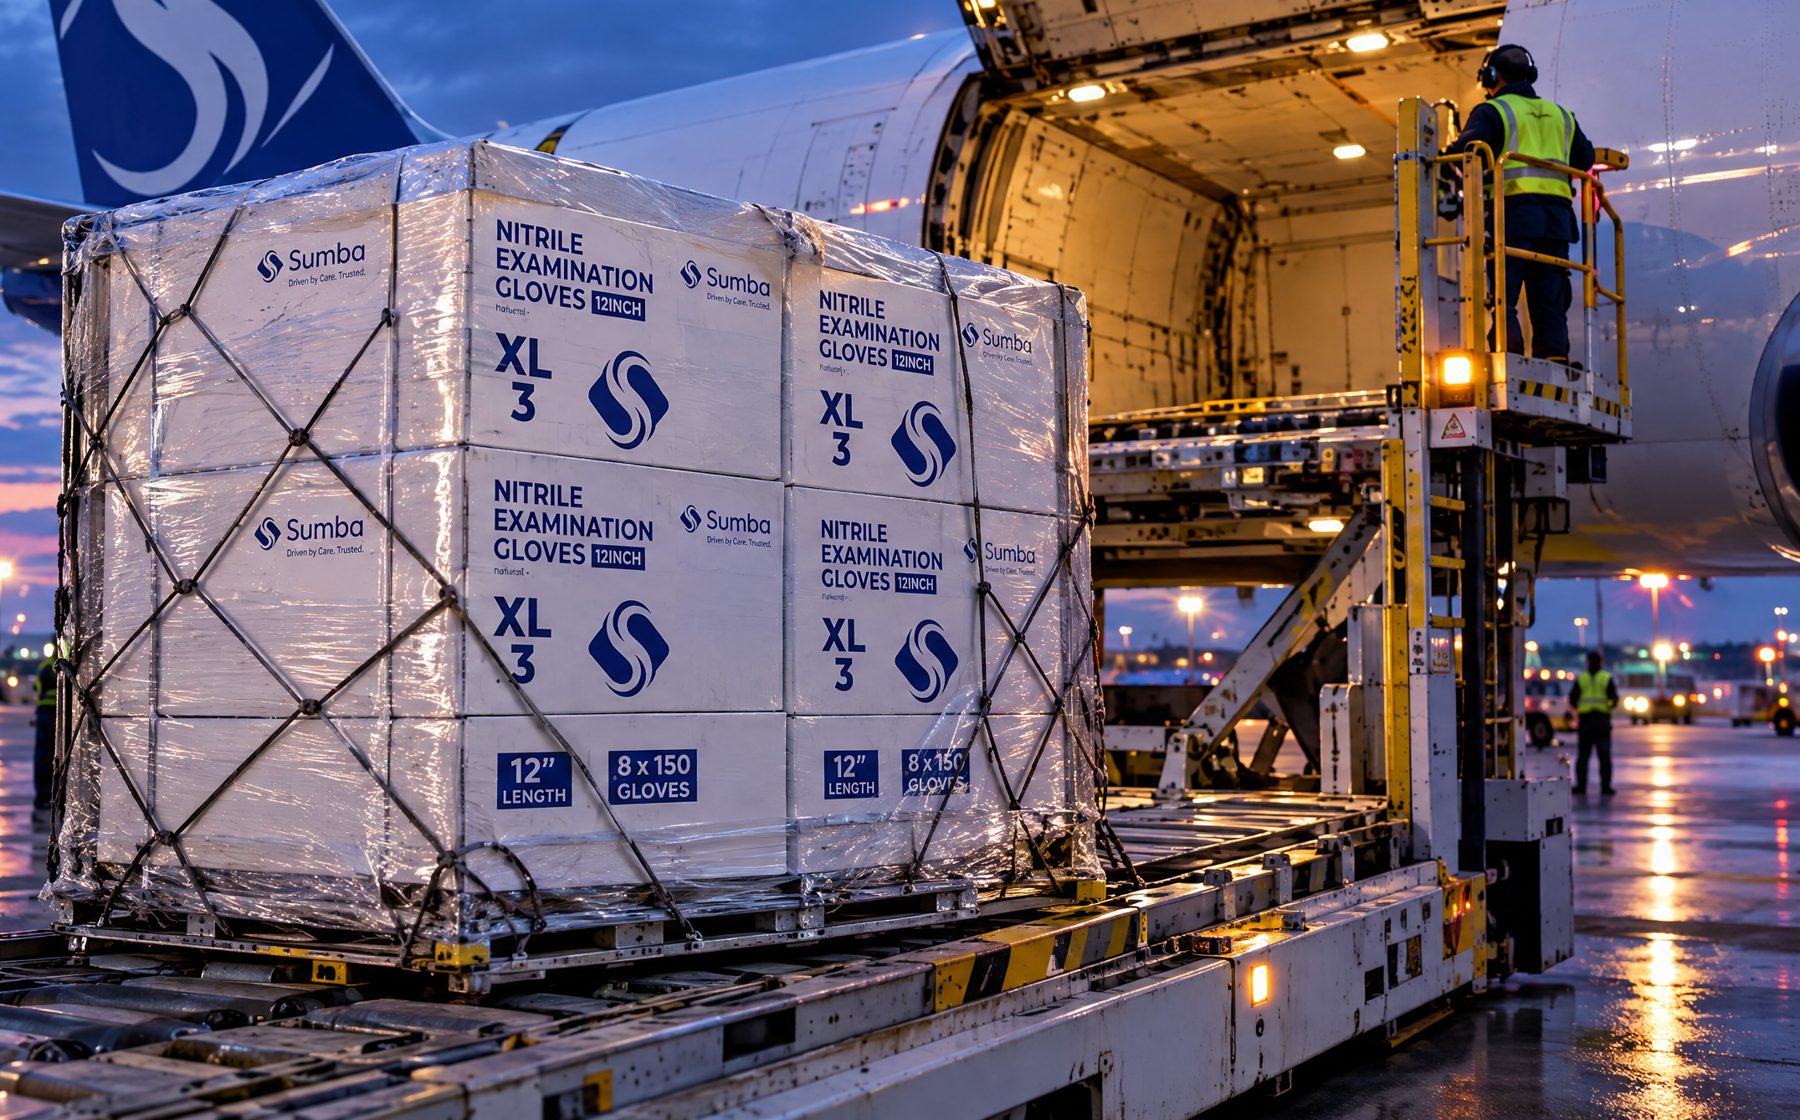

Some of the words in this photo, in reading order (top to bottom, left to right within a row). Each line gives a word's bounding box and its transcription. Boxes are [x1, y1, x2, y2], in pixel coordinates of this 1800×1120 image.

[496, 219, 584, 255] NITRILE
[289, 242, 365, 271] Sumba
[496, 247, 653, 294] EXAMINATION
[289, 279, 308, 287] Driven
[310, 276, 318, 285] by
[339, 268, 366, 279] Trusted.
[707, 267, 770, 297] Sumba
[495, 276, 585, 310] GLOVES
[595, 295, 642, 317] 12INCH
[725, 296, 732, 304] by
[819, 290, 885, 320] NITRILE
[819, 316, 940, 352] EXAMINATION
[983, 328, 1032, 353] Sumba
[495, 332, 552, 379] XL
[819, 339, 887, 366] GLOVES
[894, 353, 931, 372] 12INCH
[510, 381, 536, 422] 3
[820, 390, 863, 430] XL
[832, 432, 850, 466] 3
[494, 479, 583, 508] NITRILE
[287, 515, 363, 541] Sumba
[495, 509, 653, 542] EXAMINATION
[707, 510, 770, 534] Sumba
[821, 520, 888, 542] NITRILE
[287, 549, 307, 557] Driven
[309, 549, 317, 558] by
[318, 547, 335, 555] Care.
[337, 545, 364, 553] Trusted.
[493, 537, 585, 565] GLOVES
[595, 548, 642, 566] 12INCH
[725, 537, 732, 546] by
[986, 542, 1035, 563] Sumba
[822, 544, 943, 570] EXAMINATION
[822, 568, 890, 591] GLOVES
[898, 576, 934, 591] 12INCH
[493, 596, 552, 638] XL
[822, 618, 866, 652] XL
[510, 644, 535, 684] 3
[834, 658, 853, 692] 3
[617, 755, 632, 776] 8
[637, 761, 649, 776] x
[654, 755, 690, 776] 150
[908, 753, 919, 772] 8
[923, 759, 932, 771] x
[935, 752, 965, 771] 150
[503, 789, 566, 804] LENGTH
[617, 782, 690, 800] GLOVES
[829, 782, 875, 795] LENGTH
